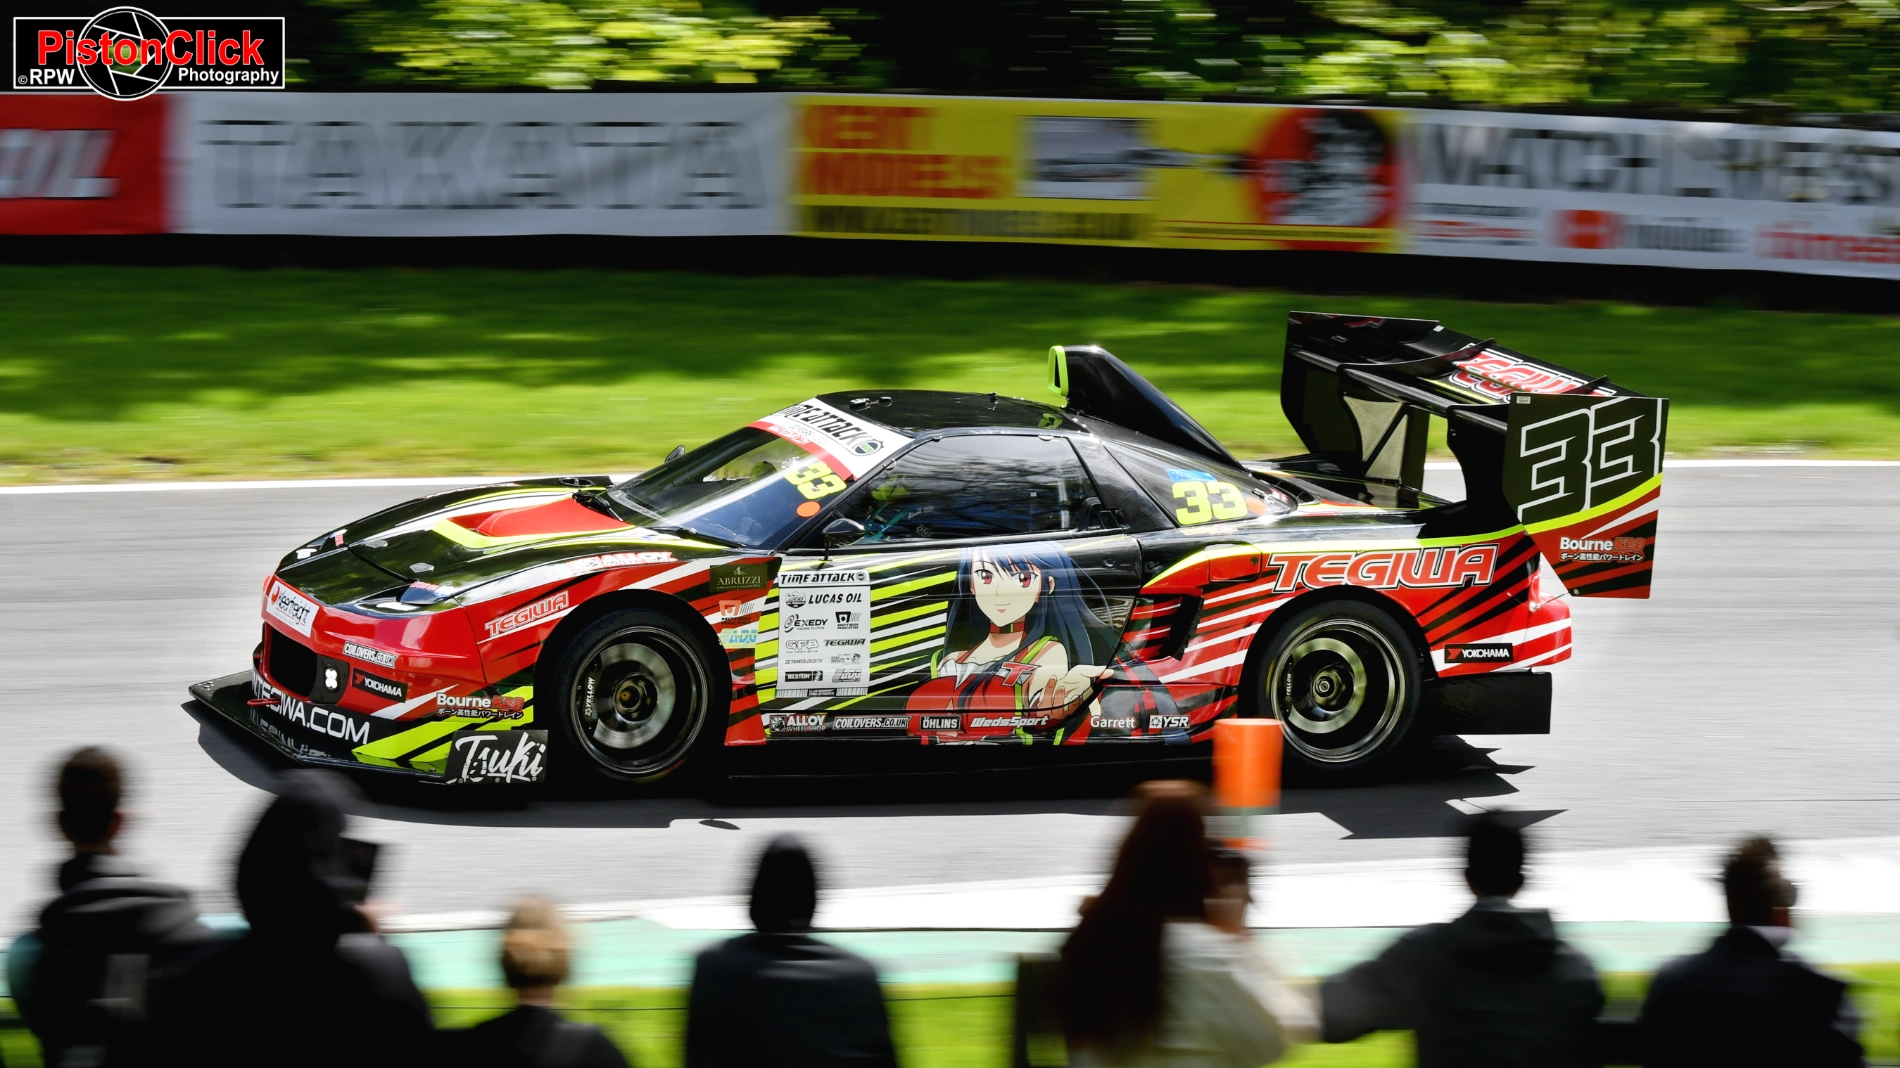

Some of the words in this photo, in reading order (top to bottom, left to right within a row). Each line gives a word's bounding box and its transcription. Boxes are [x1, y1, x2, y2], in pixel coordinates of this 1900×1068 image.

[196, 118, 764, 209] TAKATA
[1517, 396, 1662, 523] 33
[783, 462, 847, 500] 33
[1172, 481, 1248, 526] 33
[1560, 537, 1614, 551] Bourne
[1267, 543, 1499, 593] TEGIWA
[717, 576, 761, 586] ABRUZZI
[811, 573, 855, 582] ATTACK
[808, 594, 844, 605] LUCAS
[846, 593, 863, 603] OIL
[484, 590, 570, 638] TEGIWA
[794, 619, 828, 627] EXEDY
[786, 640, 819, 650] GFB
[823, 638, 866, 646] TEGIWA
[1461, 648, 1510, 658] YOKOHAMA
[364, 677, 402, 697] YOKOHAMA
[437, 693, 491, 708] Bourne
[787, 715, 826, 726] ALLOY
[835, 718, 909, 728] COILOVERS.CO.UK
[922, 714, 958, 728] ÖHLINS
[969, 715, 1049, 728] WedsSport
[1090, 716, 1135, 728] Garrett
[1163, 716, 1189, 727] YSR
